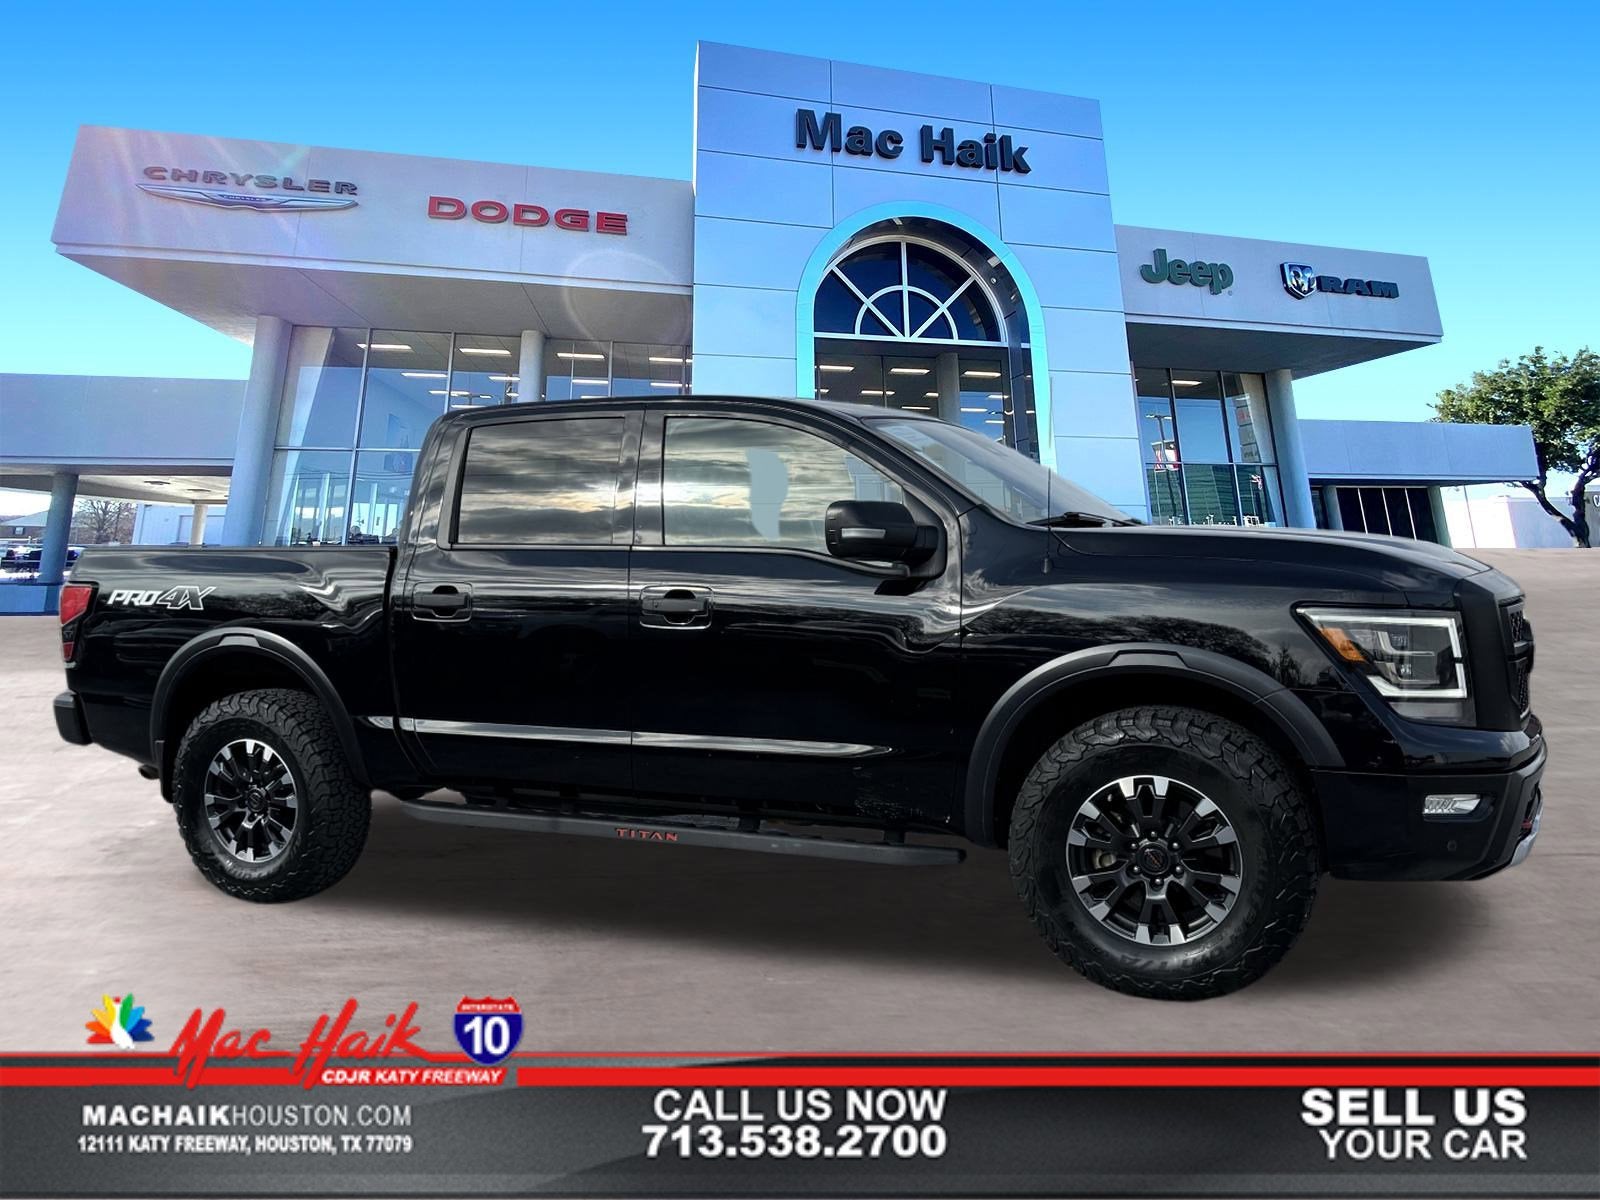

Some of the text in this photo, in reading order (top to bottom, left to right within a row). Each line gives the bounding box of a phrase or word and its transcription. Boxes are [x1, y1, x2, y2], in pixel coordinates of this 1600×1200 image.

[796, 108, 1032, 174] Mac Haik
[143, 166, 358, 196] CHRYSLER
[428, 195, 628, 236] DODGE
[1140, 248, 1234, 295] Jeep
[1316, 275, 1399, 299] RAM
[615, 828, 678, 841] TITAN
